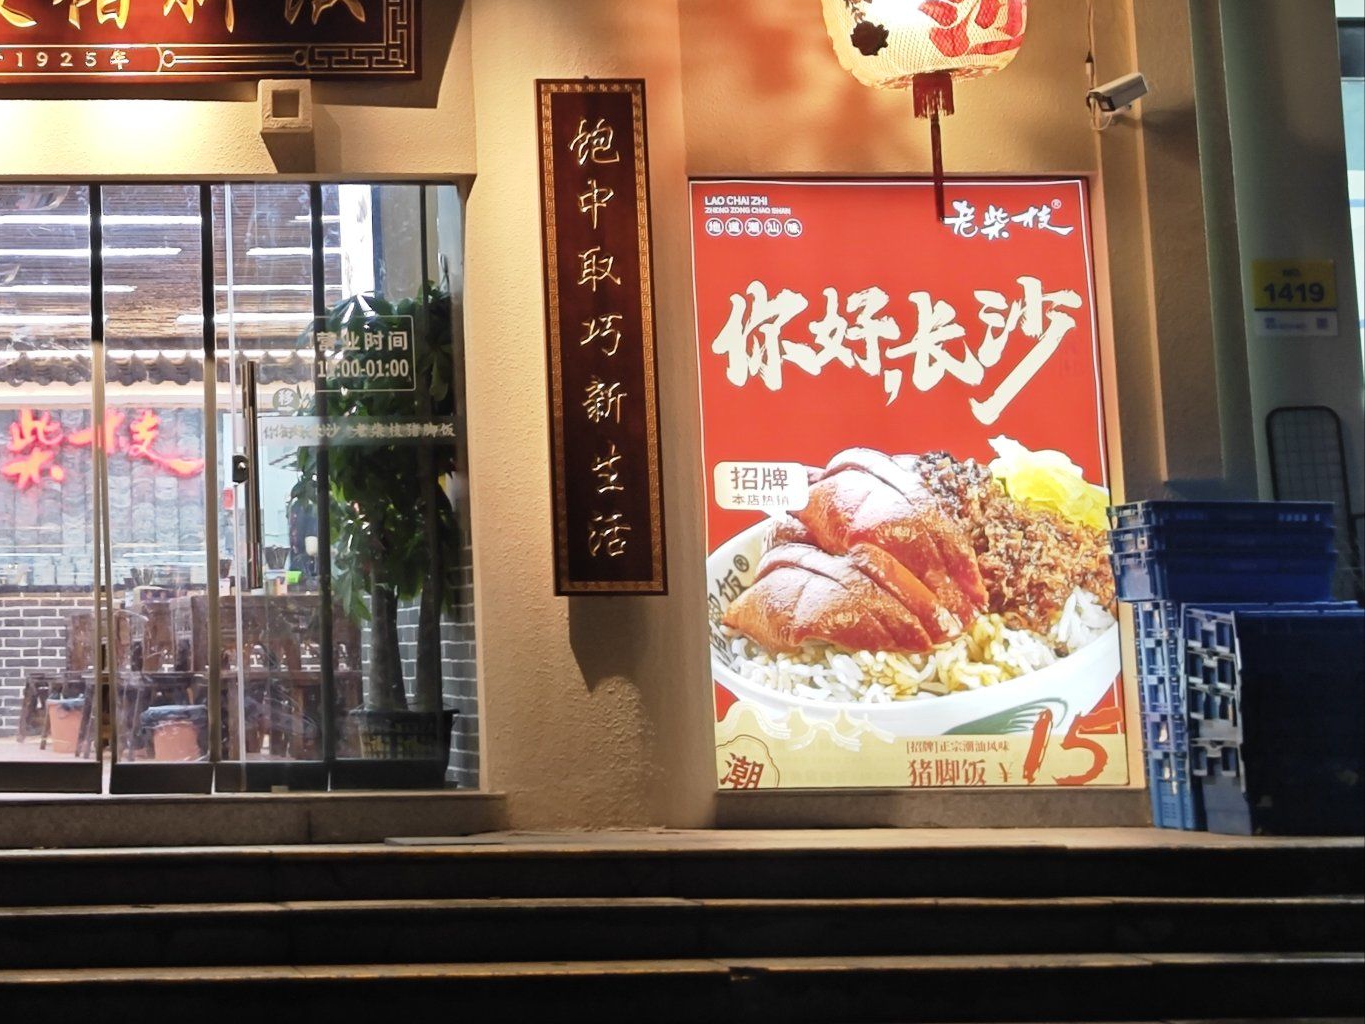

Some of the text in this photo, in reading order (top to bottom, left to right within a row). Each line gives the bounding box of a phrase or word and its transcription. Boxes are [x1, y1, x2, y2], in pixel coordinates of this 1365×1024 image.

[704, 195, 768, 206] LAO CHAI ZHI
[1263, 282, 1325, 303] 1419
[317, 330, 409, 352] 营业时间
[730, 466, 789, 491] 招牌
